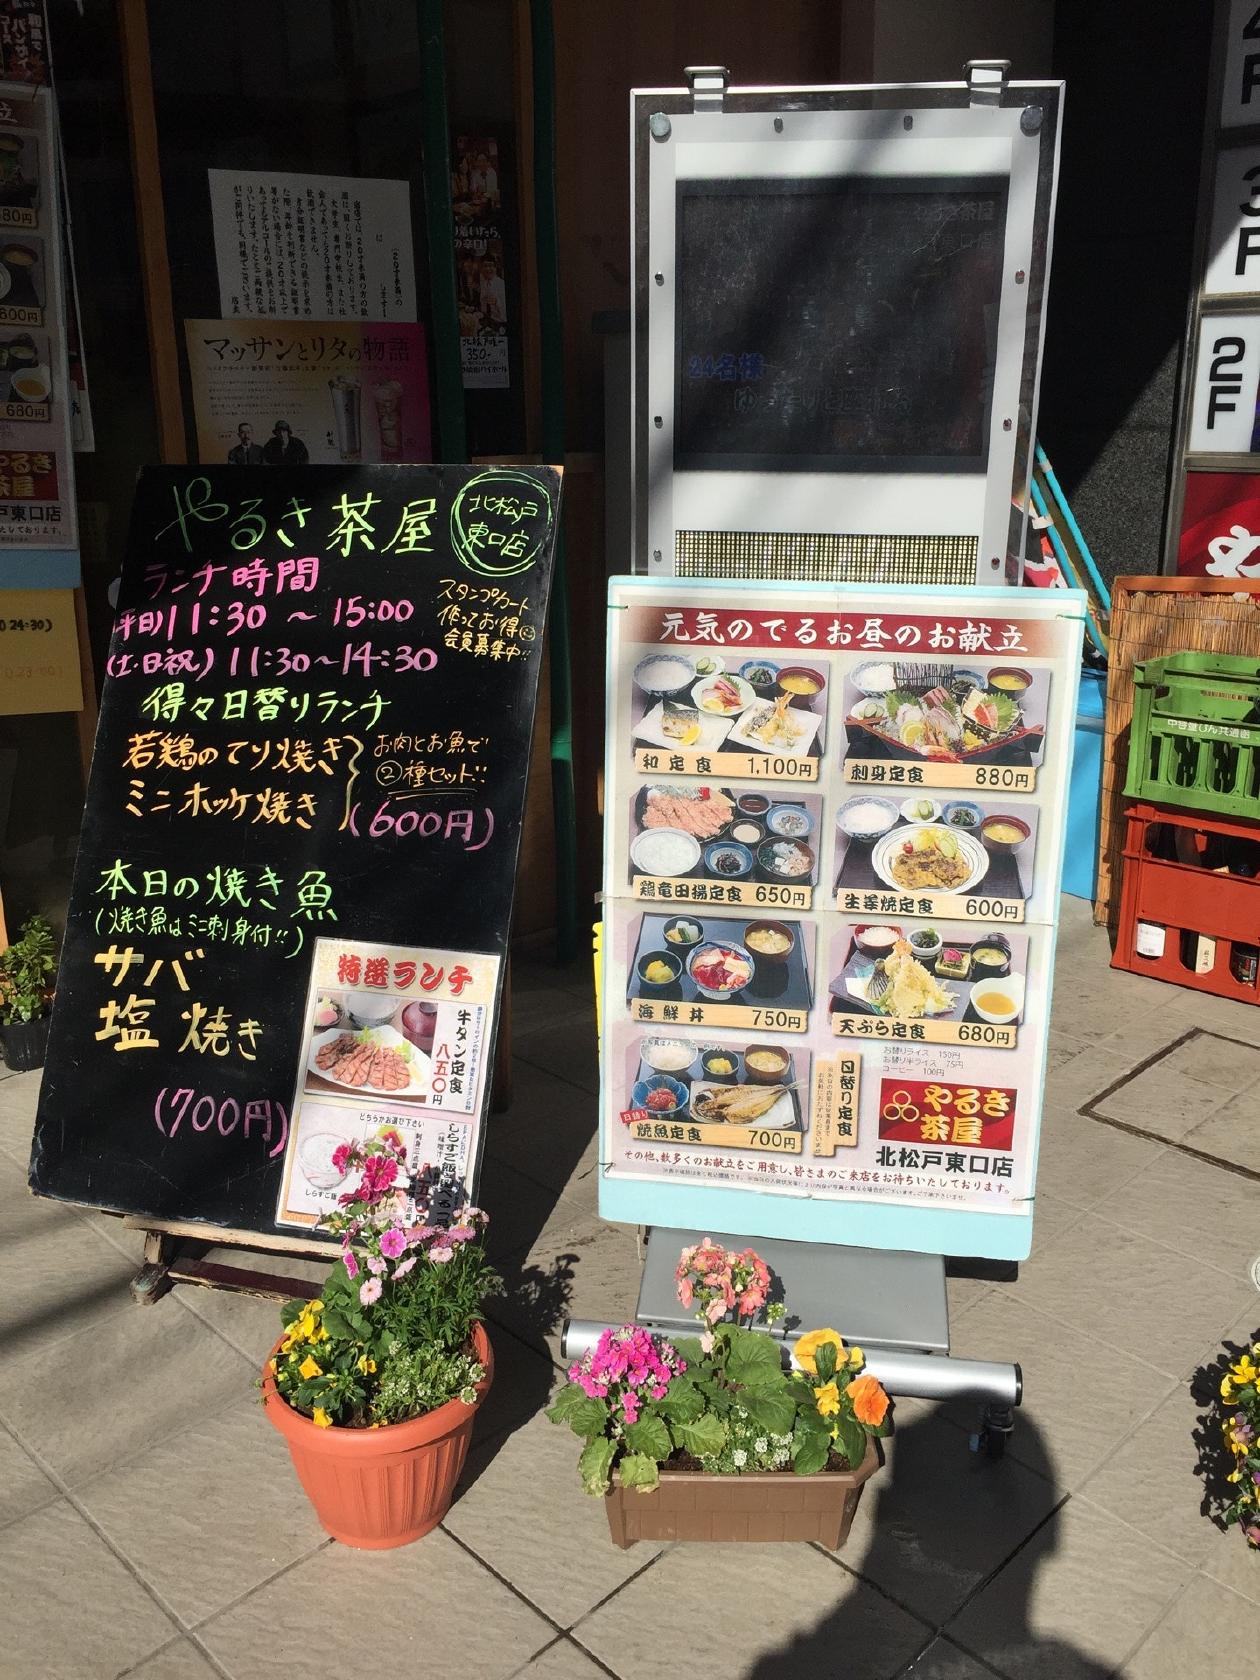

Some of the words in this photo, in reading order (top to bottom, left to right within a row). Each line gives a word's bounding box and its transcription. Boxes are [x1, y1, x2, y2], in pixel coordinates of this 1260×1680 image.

[203, 335, 410, 362] マッサンとリタの物語
[1207, 336, 1246, 431] 2F
[468, 493, 539, 525] 北松戸
[462, 521, 530, 558] 東口店
[437, 578, 529, 617] スタンプカート
[659, 610, 1030, 653] 元気のでるお昼のお献立
[373, 730, 490, 758] お肉とお魚で
[746, 757, 812, 779] 1,100円
[850, 763, 924, 784] 刺身定食
[974, 767, 1030, 788] 880円
[125, 779, 319, 831] ミニホッケ焼き
[95, 858, 339, 922] 本日の焼き魚
[755, 887, 806, 907] 650円
[965, 899, 1019, 919] 600円
[94, 944, 206, 992] サバ
[337, 953, 474, 996] 特選ランチ
[638, 1003, 705, 1022] 海鮮丼
[751, 1009, 802, 1029] 750円
[838, 1018, 926, 1040] 天ぷら定食
[957, 1025, 1011, 1045] 680円
[449, 1009, 472, 1095] 牛タン定食
[836, 1060, 856, 1137] 日替り定食
[923, 1083, 1010, 1116] やるき
[747, 1130, 797, 1151] 700円
[920, 1112, 983, 1146] 茶屋
[875, 1145, 1015, 1179] 北松戸東口店
